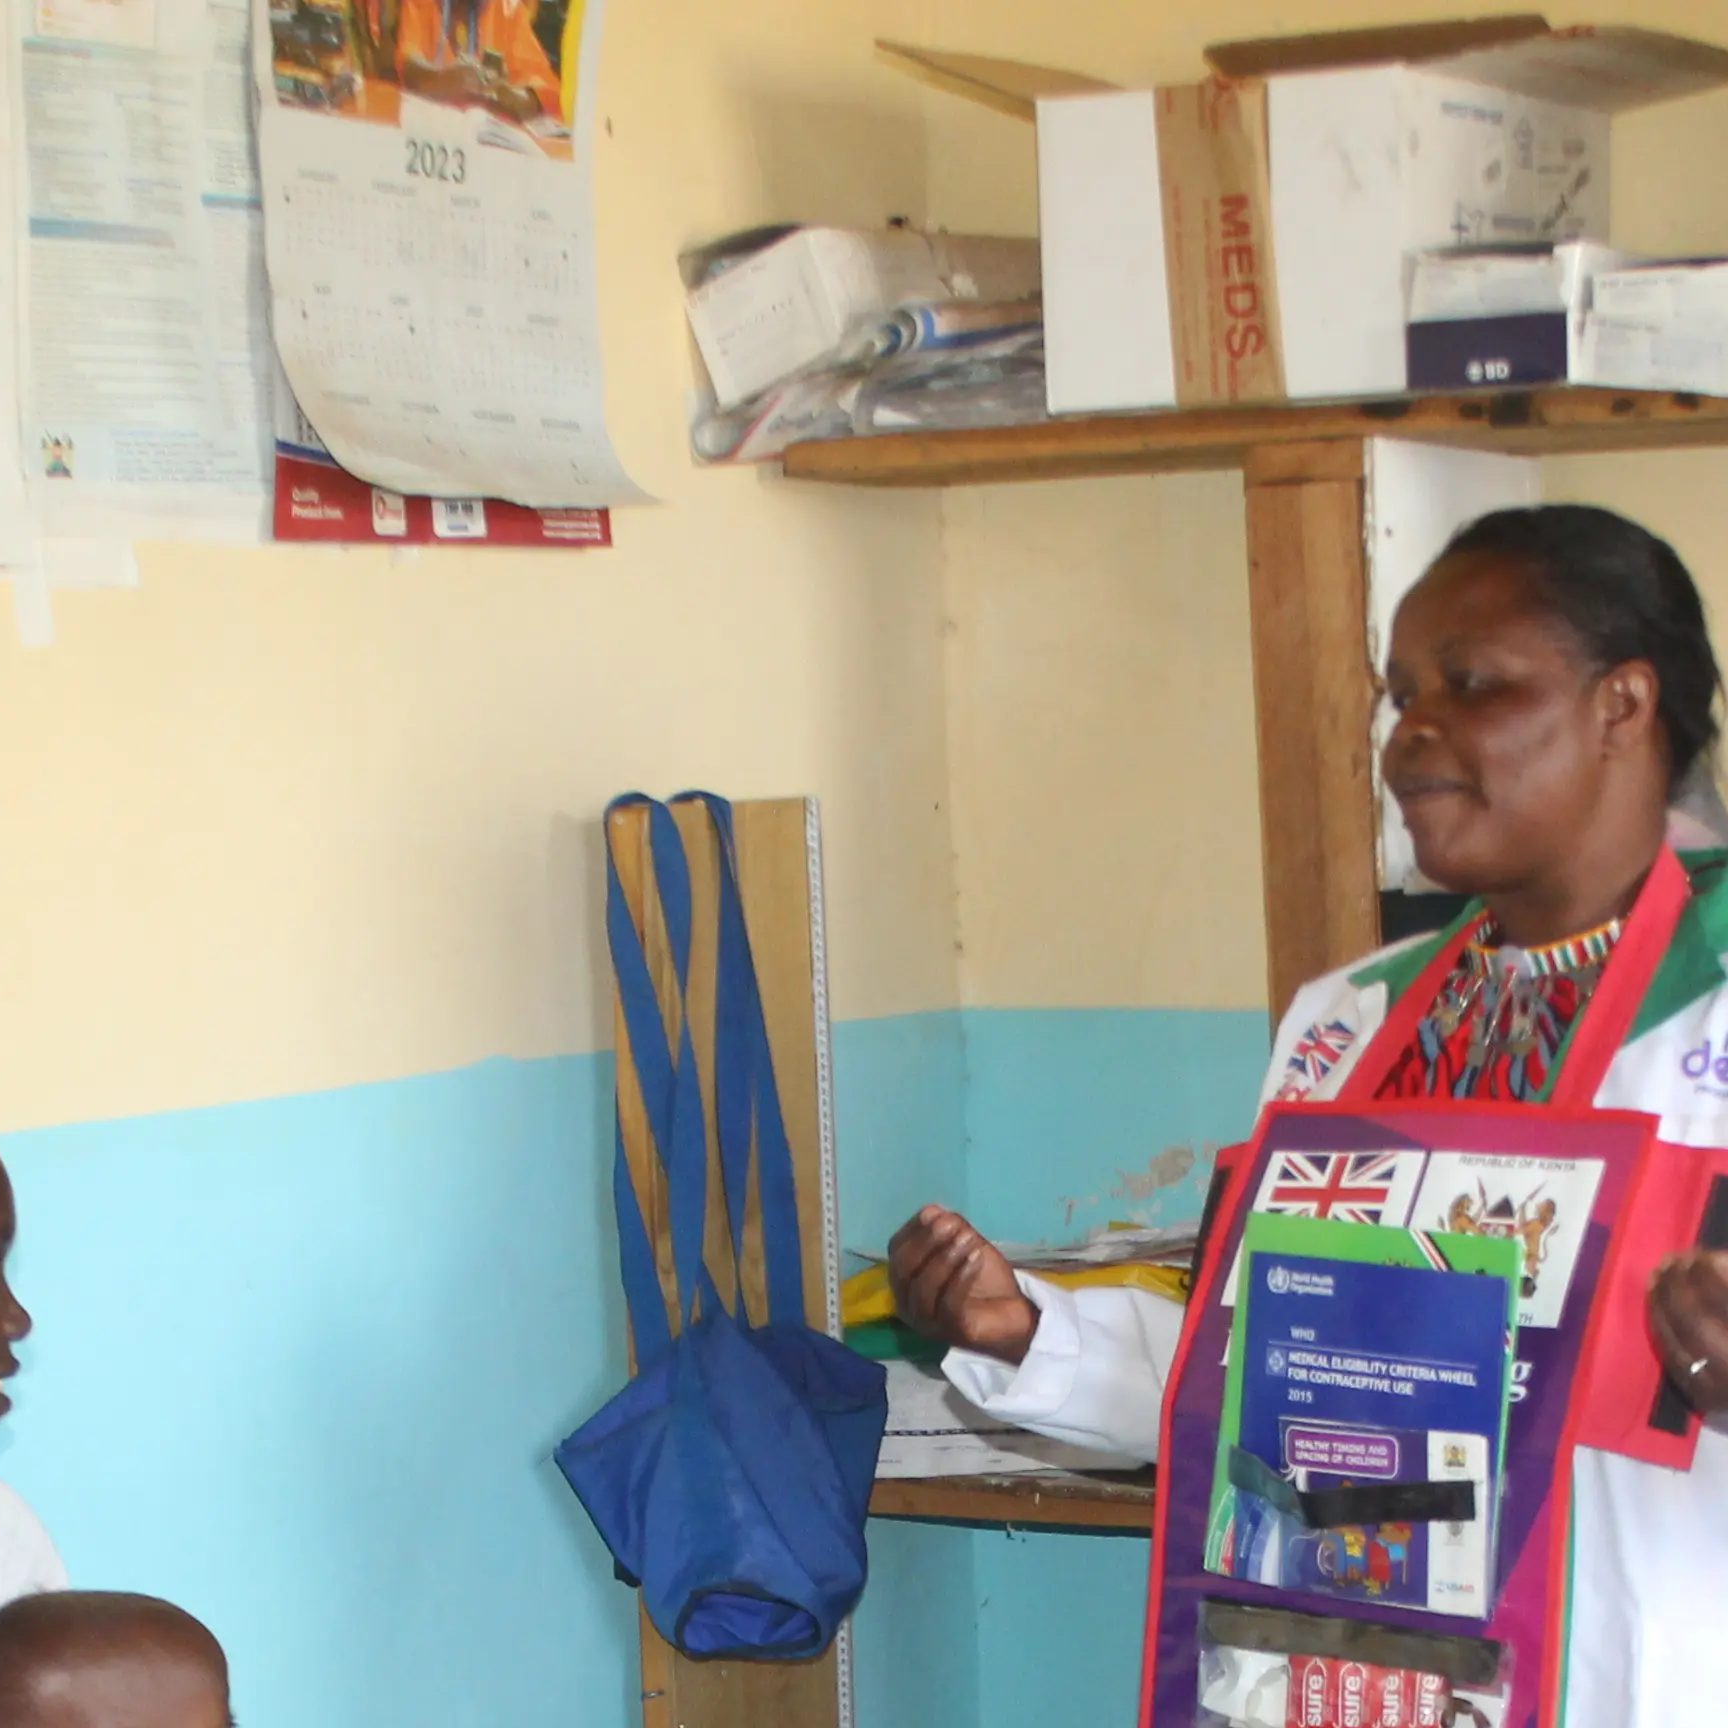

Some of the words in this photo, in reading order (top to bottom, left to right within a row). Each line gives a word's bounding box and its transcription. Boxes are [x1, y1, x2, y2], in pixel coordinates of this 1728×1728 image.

[405, 136, 466, 184] 2023
[1219, 193, 1266, 361] MEDS
[1459, 1156, 1517, 1169] REPUBLIC
[1518, 1158, 1537, 1169] OF
[1538, 1159, 1577, 1172] KENYA
[1291, 1271, 1311, 1286] World
[1312, 1274, 1335, 1288] Health
[1290, 1325, 1315, 1343] WHO
[1288, 1351, 1330, 1369] MEDICAL
[1331, 1355, 1388, 1377] ELIGIBILITY
[1389, 1363, 1438, 1382] CRITERIA
[1439, 1370, 1477, 1388] WHEEL
[1288, 1366, 1308, 1381] FOR
[1309, 1368, 1390, 1394] CONTRACEPTIVE
[1393, 1381, 1414, 1397] USE
[1288, 1386, 1314, 1404] 2015
[1295, 1438, 1330, 1452] HEALTHY
[1332, 1441, 1365, 1454] TIMING
[1367, 1443, 1387, 1456] AND
[1295, 1450, 1330, 1464] SPACING
[1331, 1453, 1343, 1464] OF
[1344, 1455, 1388, 1468] CHILDREN
[1306, 1673, 1323, 1728] sure
[1343, 1675, 1362, 1728] sure
[1381, 1674, 1400, 1728] sure
[1419, 1671, 1439, 1726] sure
